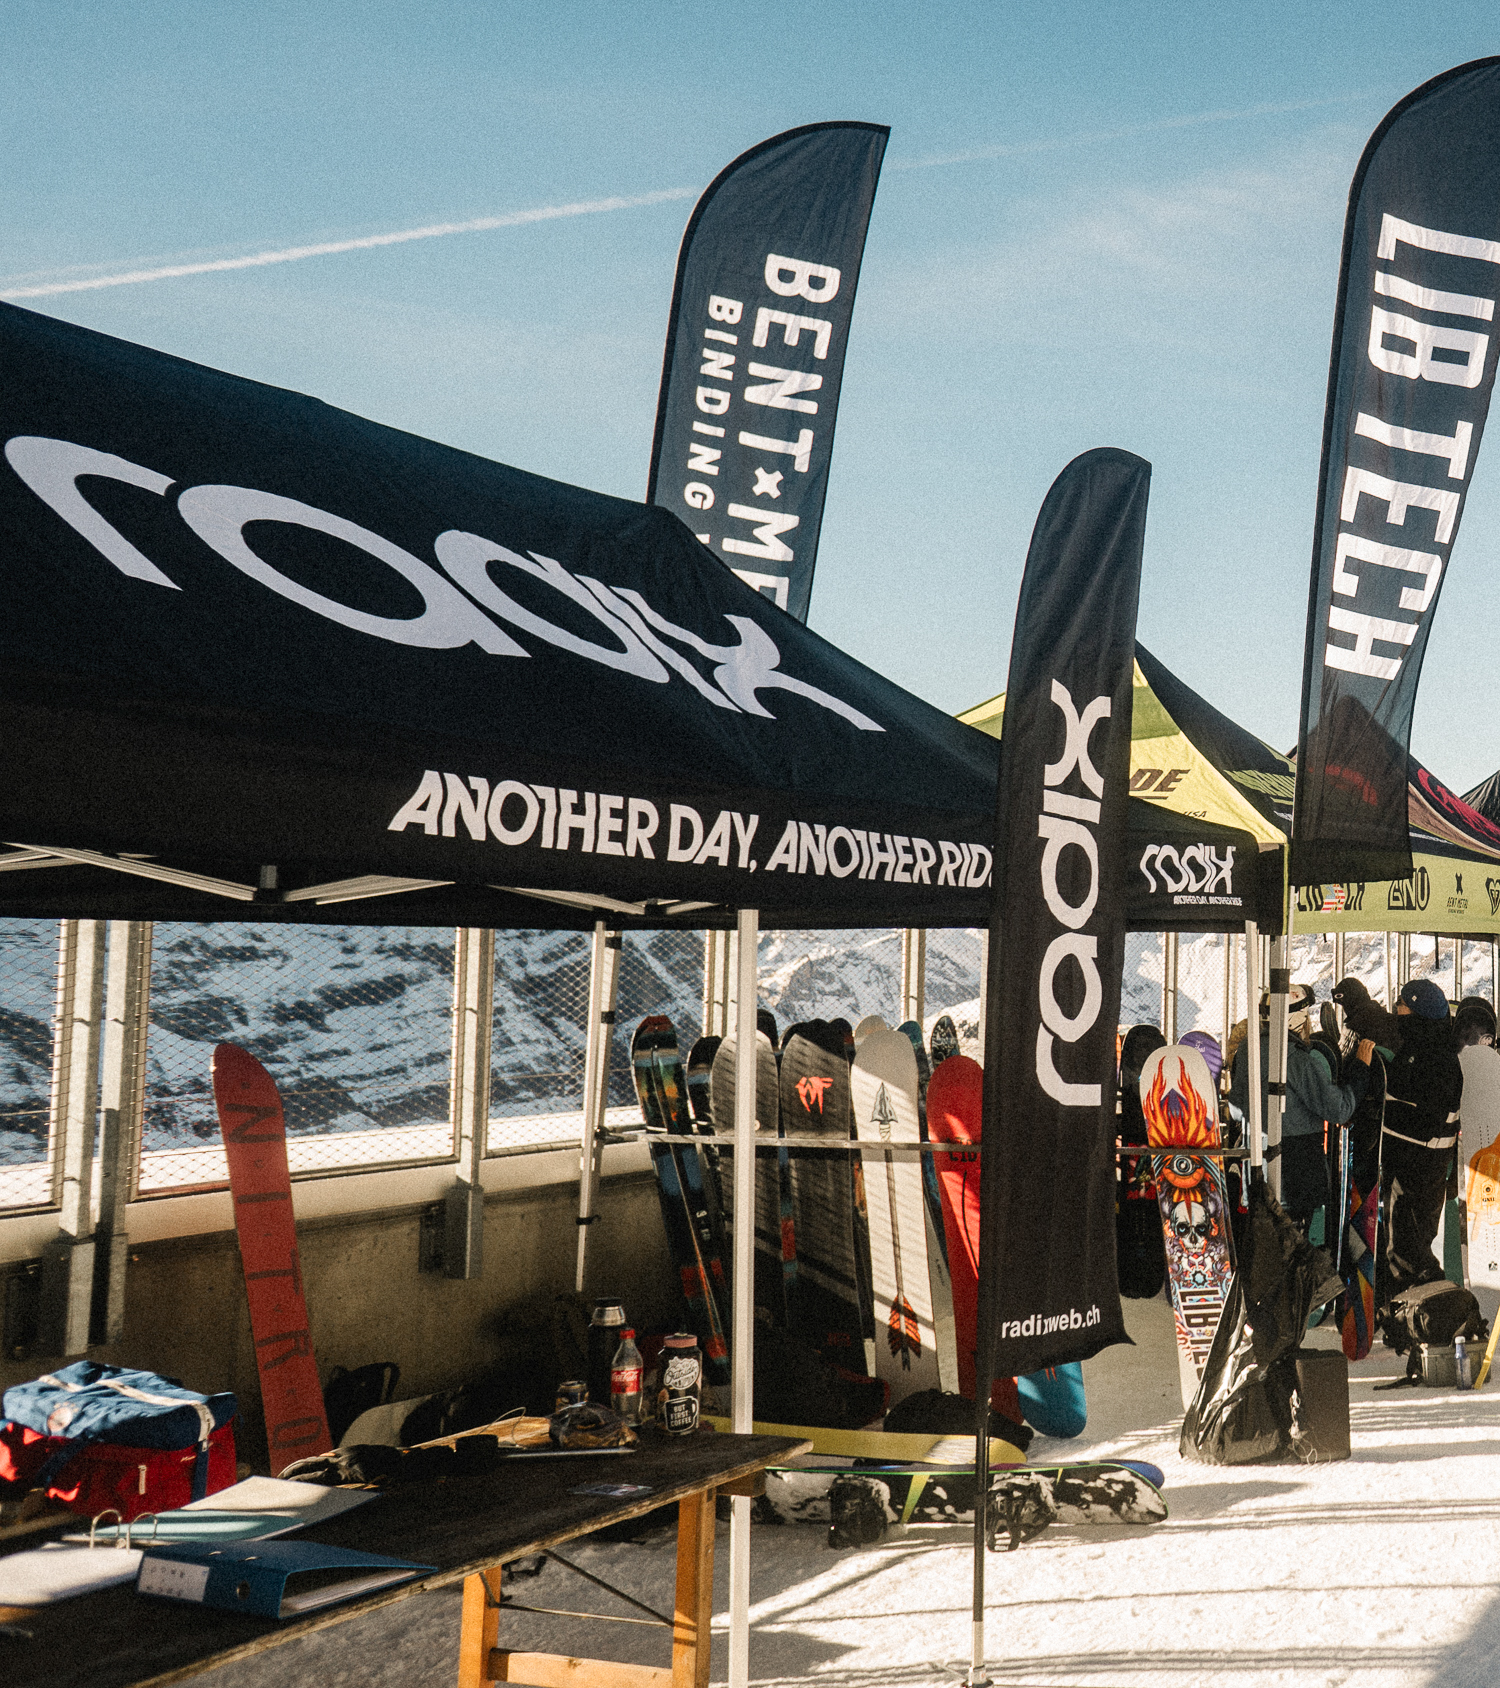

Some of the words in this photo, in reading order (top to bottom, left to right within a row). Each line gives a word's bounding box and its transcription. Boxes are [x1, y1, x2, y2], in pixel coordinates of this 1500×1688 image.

[683, 294, 744, 511] BINDING
[736, 252, 842, 474] BENT
[1323, 411, 1473, 681] TECH
[388, 769, 659, 861] ANOTHER
[667, 804, 760, 874] DAY,
[764, 820, 937, 884] ANOTHER
[937, 840, 993, 888] RID
[1387, 866, 1431, 911] GNU
[1001, 1304, 1101, 1339] radixweb.ch
